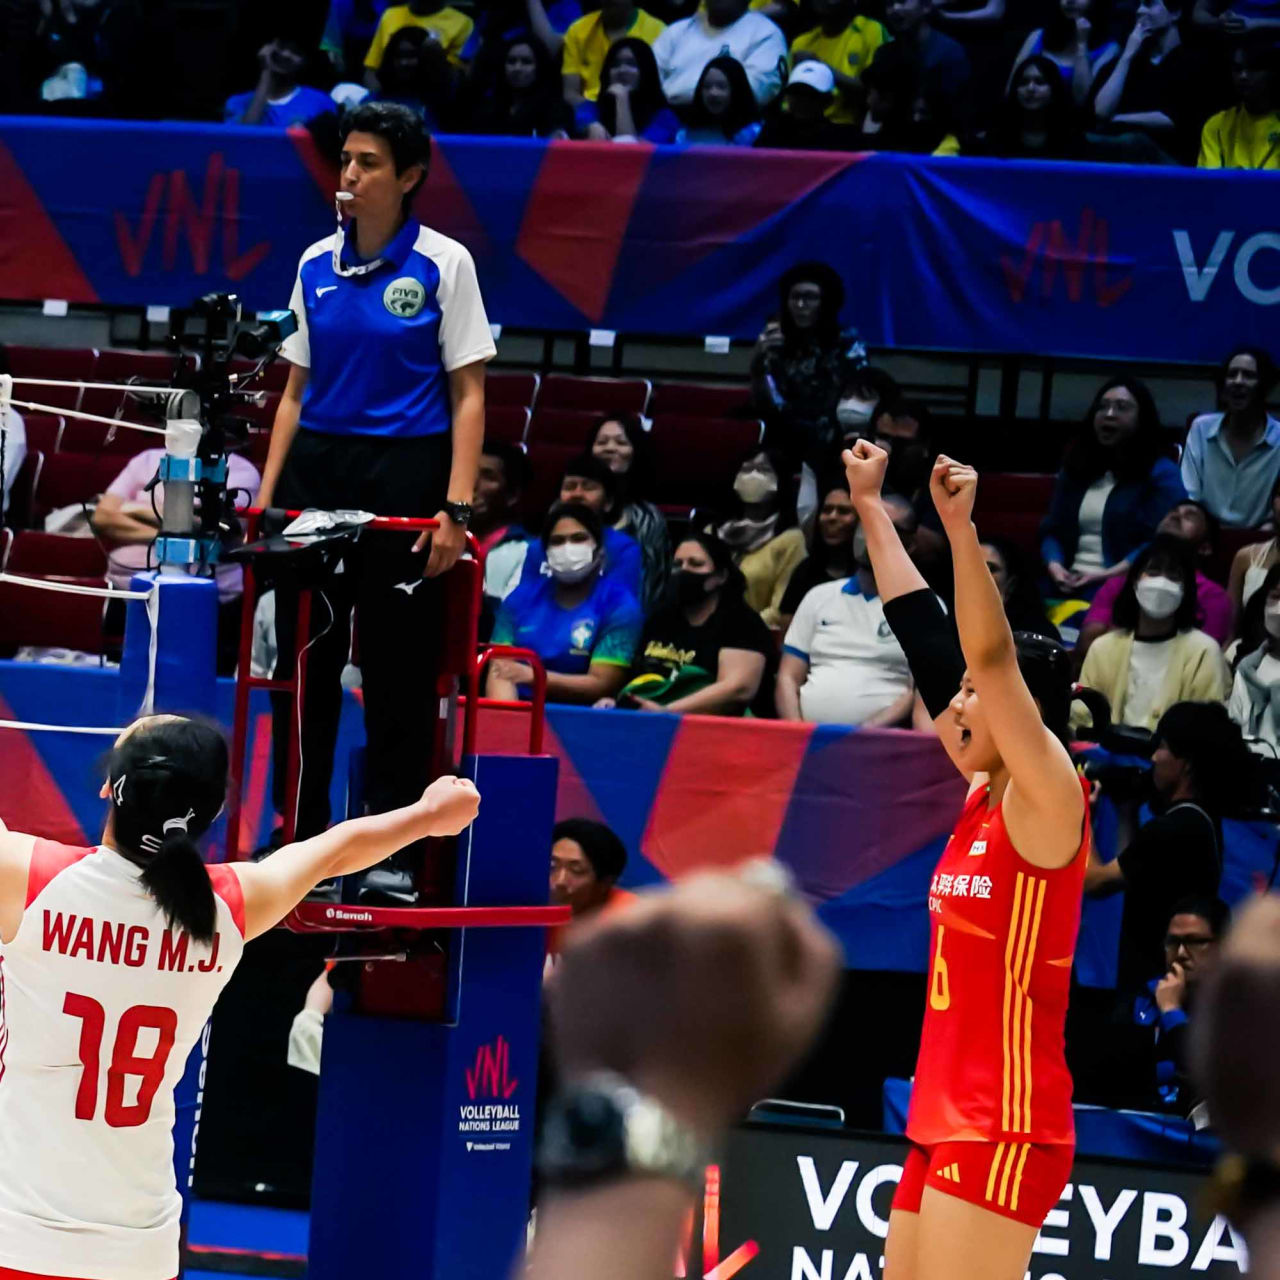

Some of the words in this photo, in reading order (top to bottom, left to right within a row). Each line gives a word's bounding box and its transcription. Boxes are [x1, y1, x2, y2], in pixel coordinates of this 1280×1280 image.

[392, 287, 419, 299] FIVB
[42, 909, 150, 967] WANG
[157, 928, 223, 973] M.J.
[930, 925, 951, 1011] 6
[62, 991, 178, 1128] 18
[465, 1034, 518, 1100] VNL
[459, 1120, 491, 1132] NATIONS
[492, 1120, 520, 1131] LEAGUE
[460, 1104, 520, 1119] VOLLEYBALL
